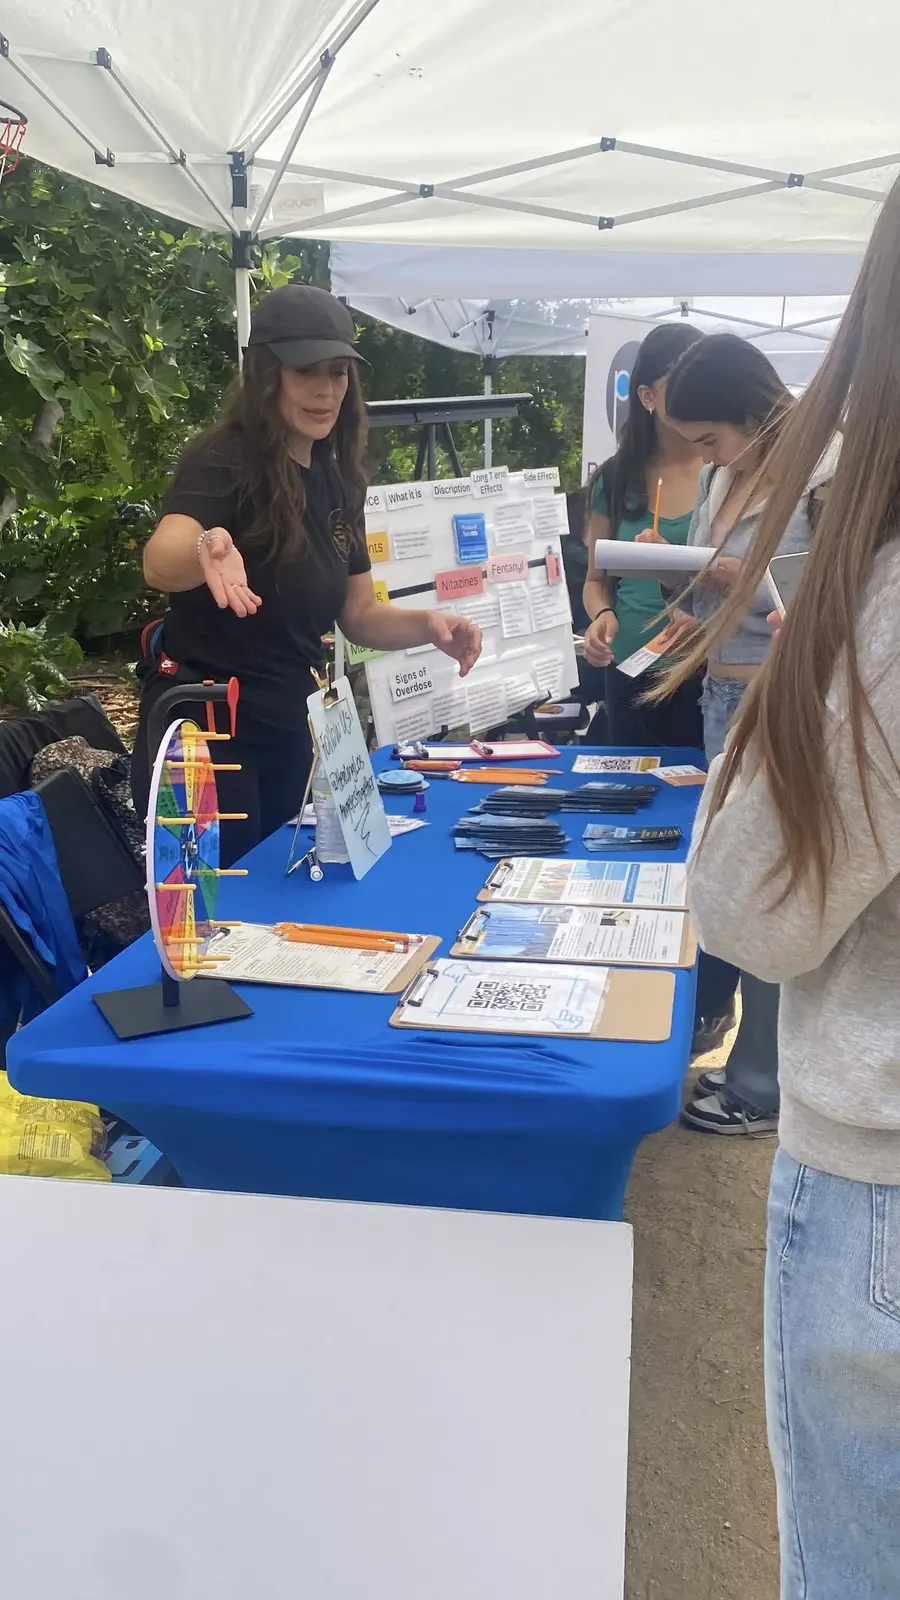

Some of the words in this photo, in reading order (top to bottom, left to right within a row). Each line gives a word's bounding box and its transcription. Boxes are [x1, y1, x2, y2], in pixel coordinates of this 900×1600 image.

[473, 474, 488, 484] Long
[524, 473, 537, 482] Side
[388, 492, 408, 503] What
[408, 489, 415, 500] it
[415, 488, 422, 498] is
[434, 484, 471, 495] Discription
[480, 484, 503, 494] Effects
[492, 561, 524, 575] Fentanyl
[441, 576, 479, 591] Nitazines
[395, 671, 417, 684] Signs
[418, 667, 427, 678] of
[395, 680, 432, 697] Overdose
